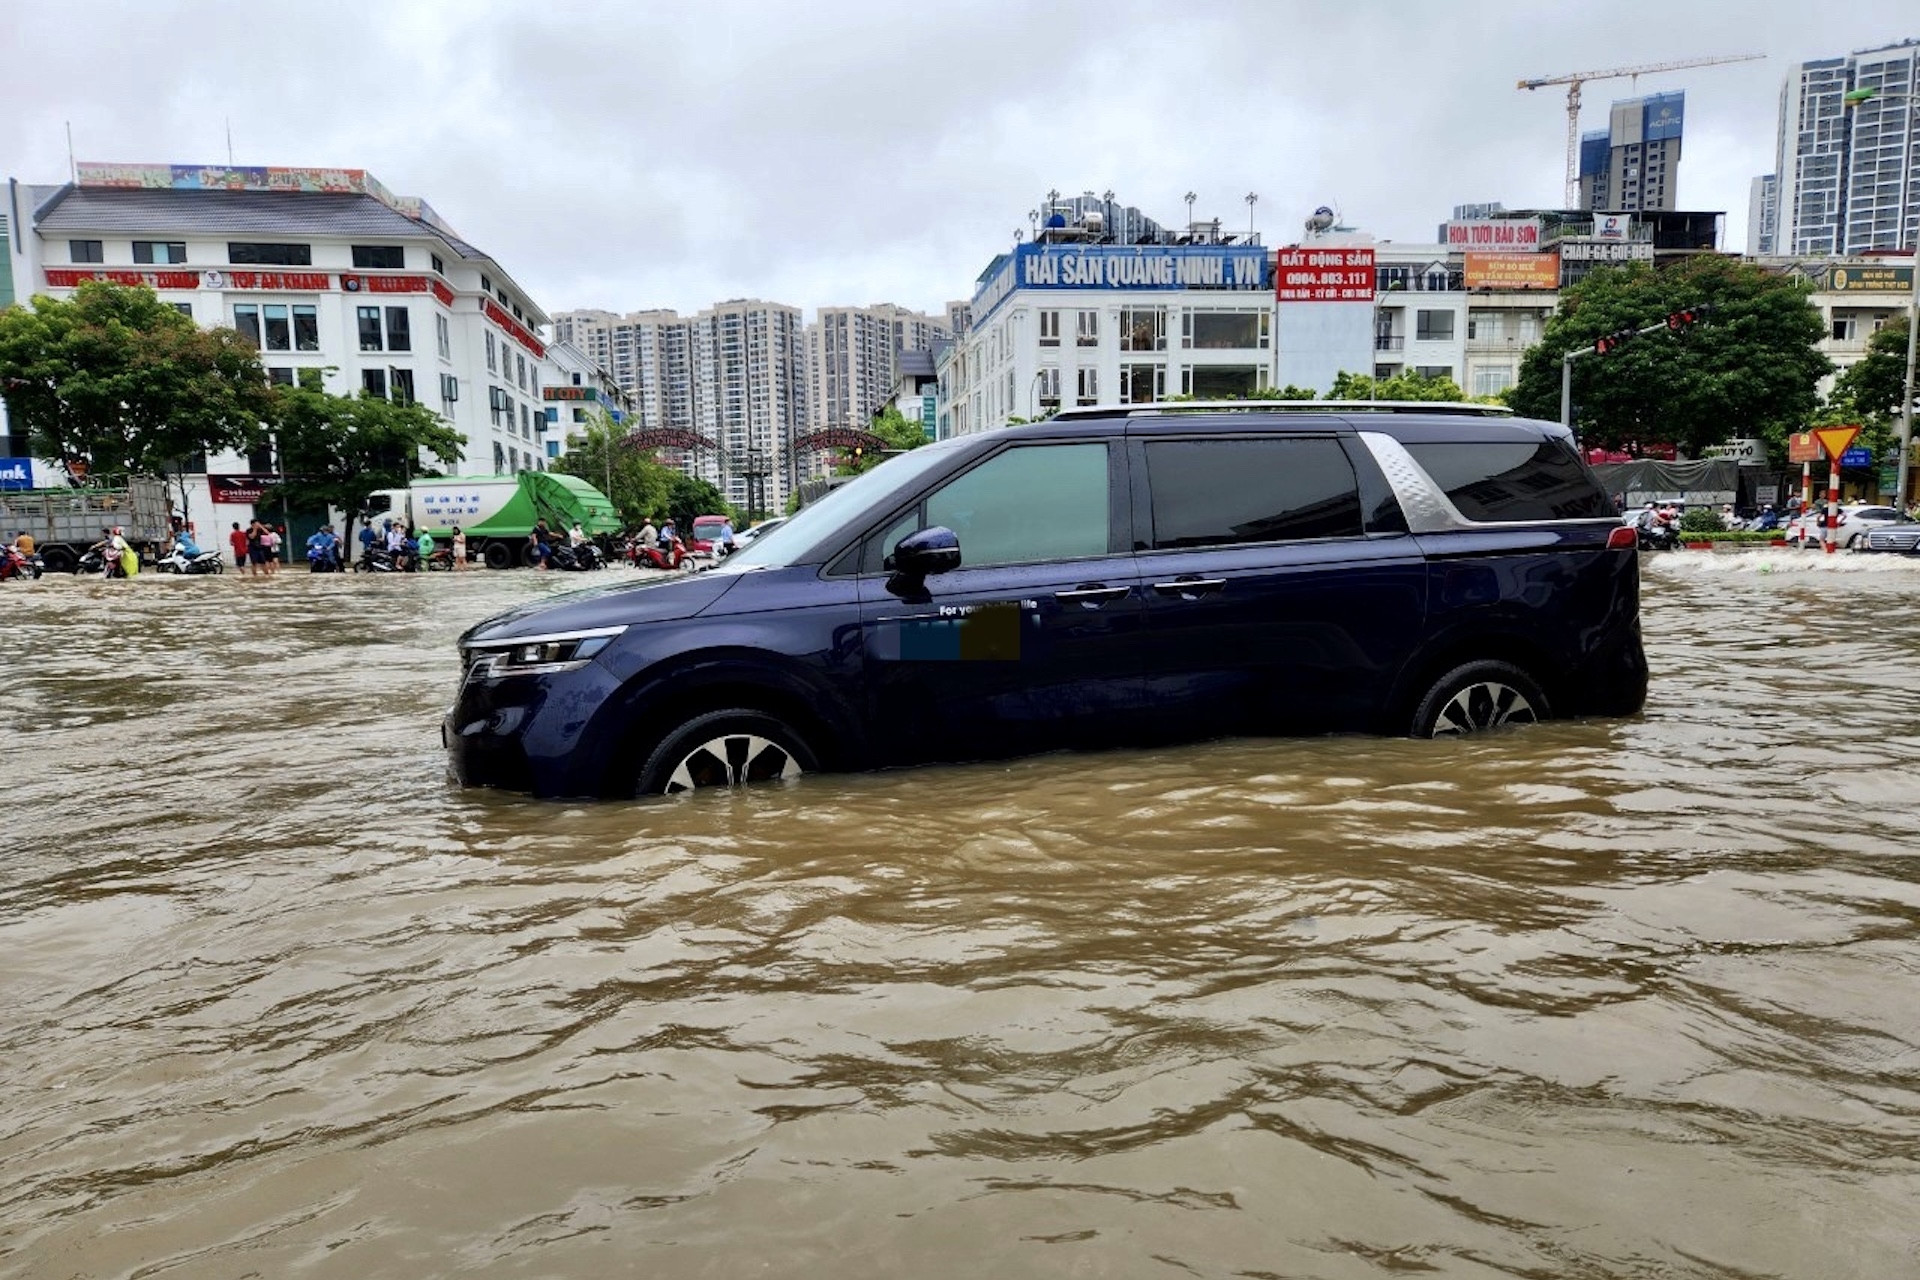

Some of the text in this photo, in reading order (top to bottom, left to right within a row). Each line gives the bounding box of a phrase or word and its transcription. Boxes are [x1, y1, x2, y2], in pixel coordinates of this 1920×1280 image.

[1449, 220, 1537, 243] HOA TƯƠI BẢO SƠN
[1025, 247, 1058, 284] HẢI
[1063, 247, 1102, 284] SẢN
[1107, 247, 1174, 287] QUẢNG
[1281, 250, 1372, 268] BẤT ĐỘNG SẢN
[939, 605, 957, 616] For
[1020, 599, 1038, 609] life
